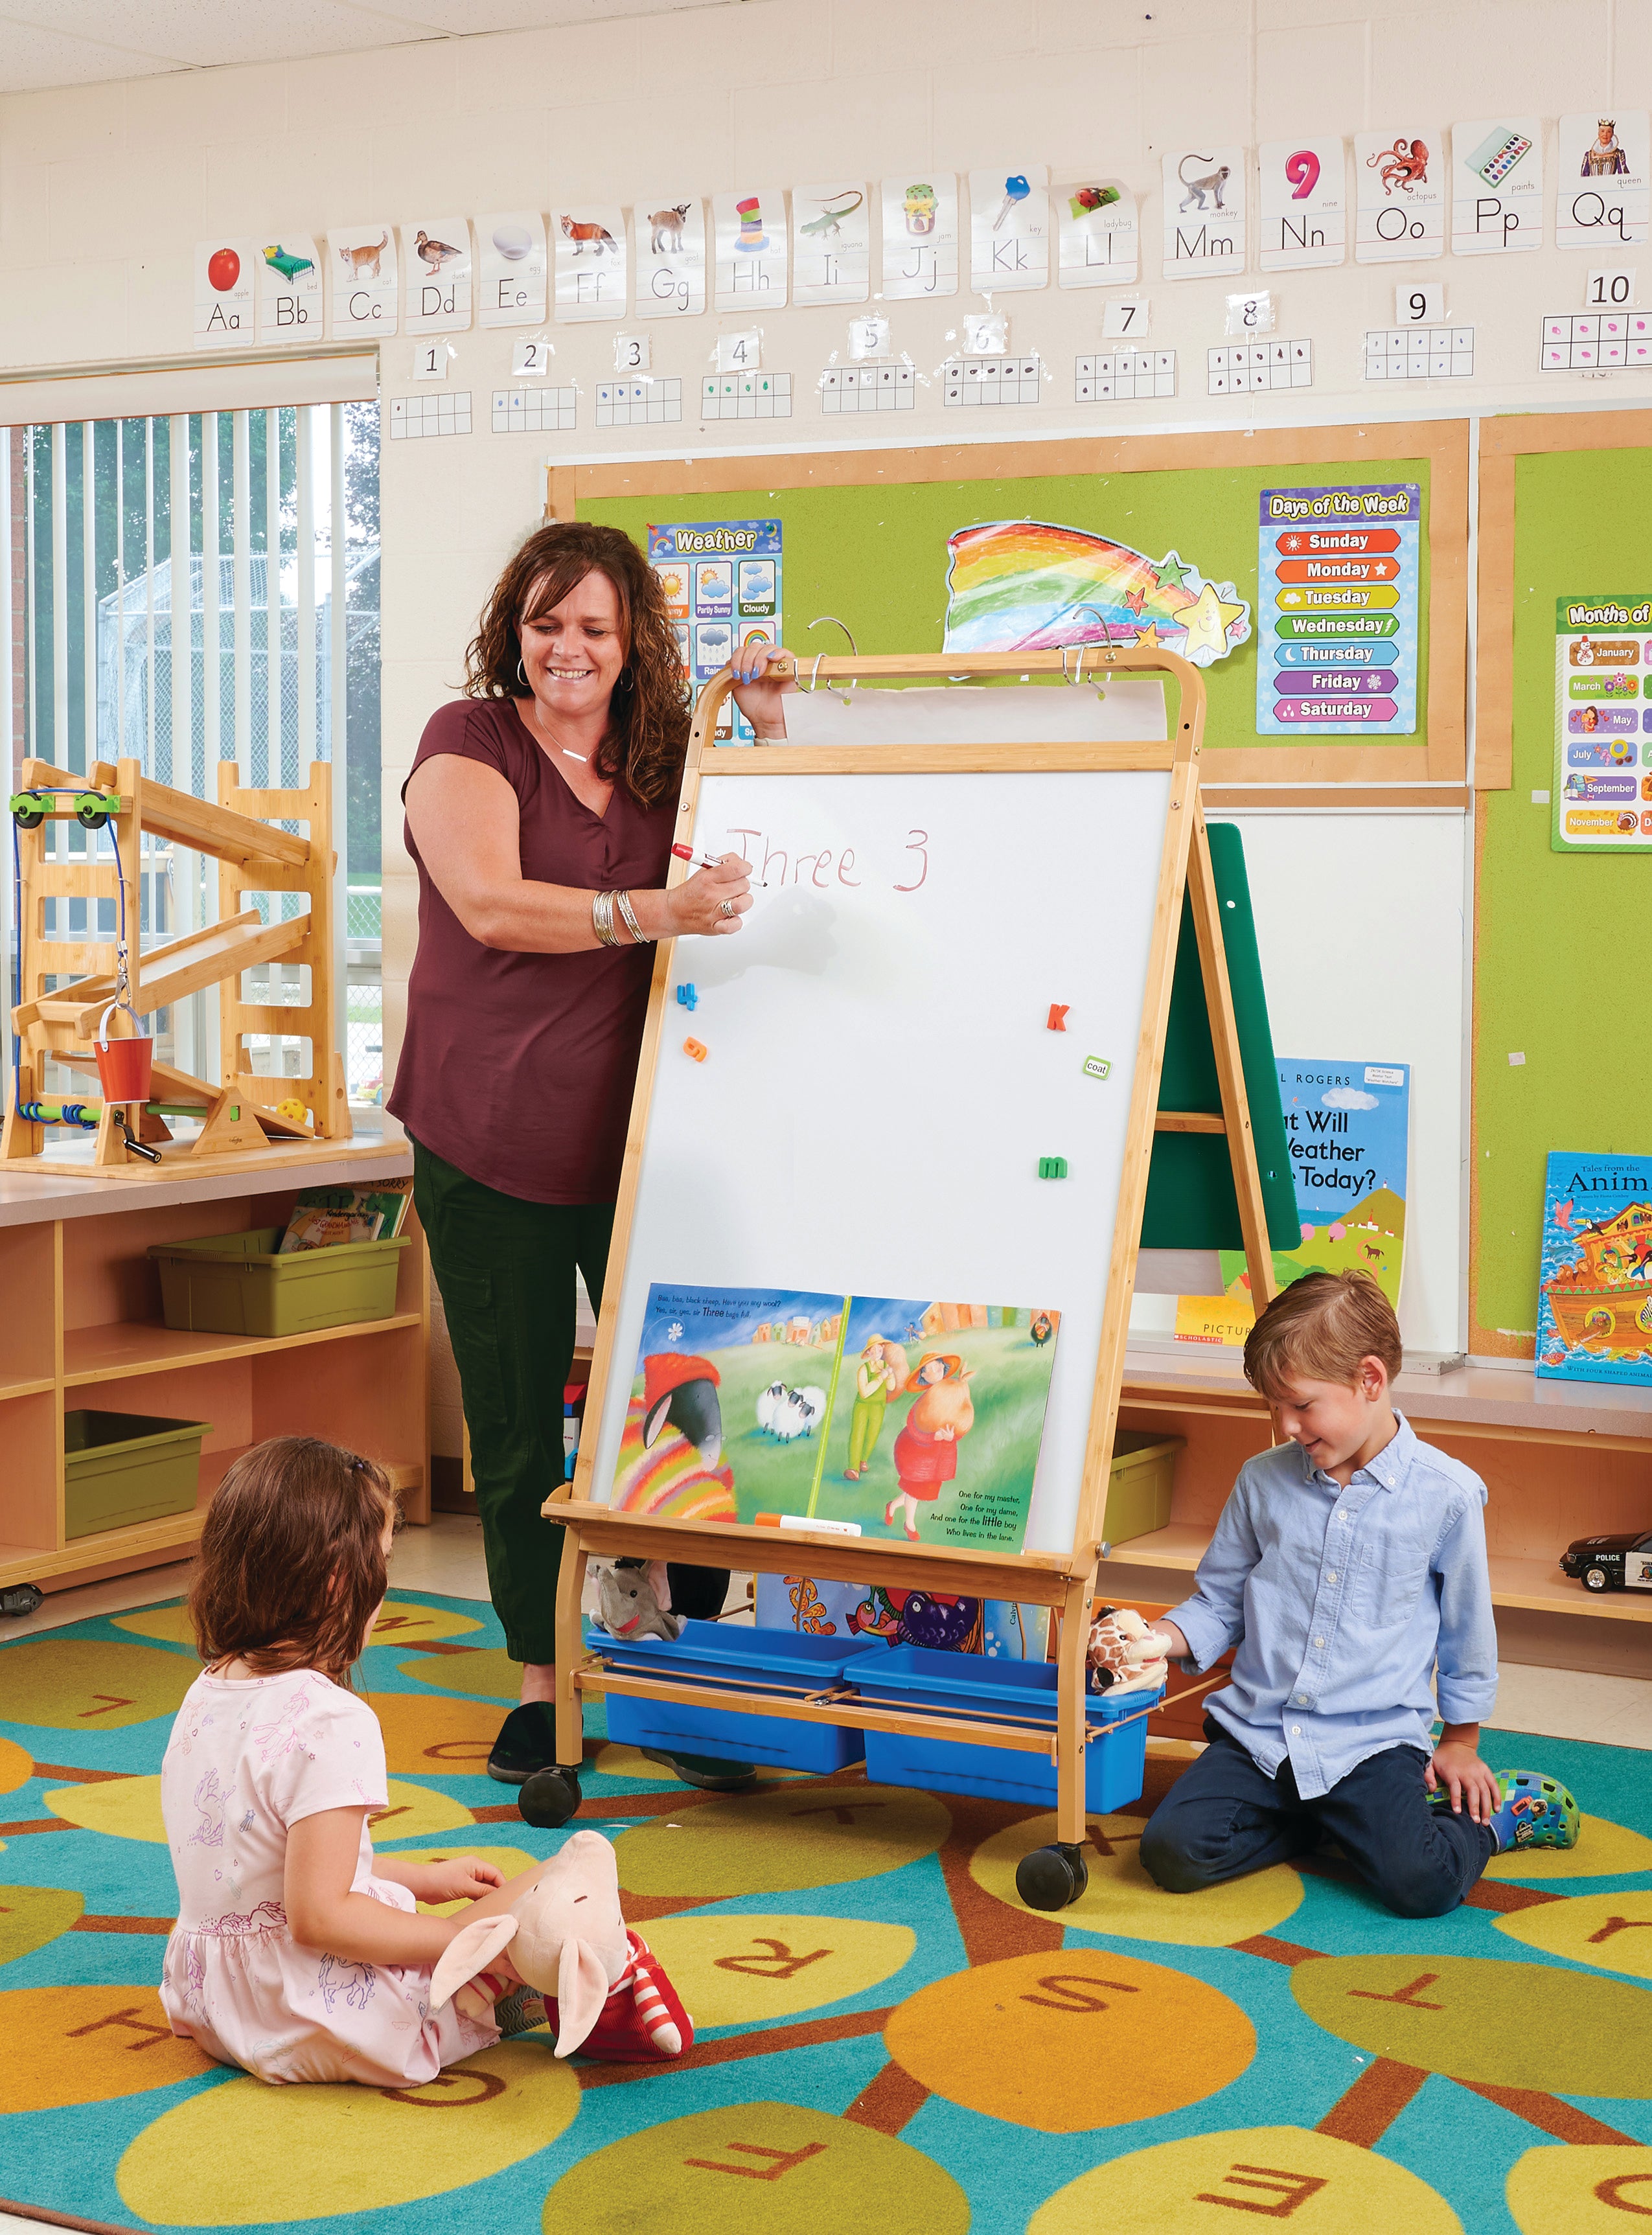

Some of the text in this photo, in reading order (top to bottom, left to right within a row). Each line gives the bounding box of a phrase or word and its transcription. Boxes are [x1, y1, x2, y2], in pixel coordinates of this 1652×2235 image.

[1511, 182, 1535, 193] paints
[1617, 177, 1642, 188] queen
[1406, 192, 1437, 202] octopus
[1104, 219, 1132, 229] ladybug
[1210, 209, 1239, 221] monkey
[1377, 208, 1425, 240] Oo
[1476, 198, 1519, 247] Pp
[1572, 192, 1632, 241] Qq
[937, 233, 952, 243] jam
[1029, 224, 1042, 235] key
[1281, 215, 1325, 249] Nn
[842, 241, 863, 251] iguana
[1086, 233, 1112, 266] Ll
[1176, 224, 1233, 259] Mm
[685, 254, 699, 264] goat
[992, 239, 1029, 272] Kk
[529, 266, 541, 275] egg
[733, 260, 770, 292] Hh
[823, 254, 838, 285] Ii
[902, 246, 937, 292] Jj
[234, 289, 249, 299] apple
[307, 282, 317, 290] bed
[498, 279, 527, 308] Ee
[577, 272, 606, 303] Ff
[651, 268, 689, 311] Gg
[1592, 276, 1629, 303] 10
[349, 291, 382, 320] Cc
[422, 284, 455, 315] Dd
[1409, 293, 1427, 320] 9
[207, 303, 240, 332] Aa
[277, 297, 308, 325] Bb
[1121, 307, 1136, 332] 7
[1243, 300, 1257, 327] 8
[865, 323, 878, 348] 5
[426, 349, 438, 372] 1
[523, 345, 536, 367] 2
[628, 342, 641, 365] 3
[732, 340, 748, 363] 4
[1272, 493, 1407, 518] Days of the Week
[676, 530, 755, 552] Weather
[1309, 534, 1369, 551] Sunday
[1307, 562, 1370, 579] Monday
[743, 604, 770, 614] Cloudy
[1305, 590, 1370, 606] Tuesday
[697, 605, 731, 615] Partly Sunny
[1569, 604, 1650, 625] Months of
[1292, 617, 1384, 635] Wednesday
[1301, 646, 1373, 663] Thursday
[1596, 648, 1634, 658] January
[1312, 674, 1361, 691] Friday
[1573, 682, 1601, 691] March
[1300, 701, 1371, 718] Saturday
[1613, 715, 1632, 726] May
[1573, 749, 1592, 759] July
[1587, 783, 1635, 794] September
[1570, 818, 1613, 827] November
[726, 829, 928, 891] Three 3
[1087, 1062, 1107, 1074] coat
[1296, 1074, 1350, 1086] ROGERS
[1305, 1110, 1348, 1134] Will
[1299, 1165, 1376, 1197] Today?
[703, 1307, 724, 1317] Three
[959, 1490, 971, 1498] One
[985, 1495, 995, 1503] my
[982, 1515, 1002, 1528] little
[1004, 1520, 1017, 1531] boy
[986, 1507, 997, 1516] my
[999, 1507, 1018, 1517] dame,
[946, 1528, 961, 1536] Who
[962, 1530, 977, 1538] lives
[987, 1531, 997, 1540] the
[998, 1533, 1014, 1542] lane.
[714, 1938, 834, 1979] R
[1020, 1974, 1141, 2013] S
[1346, 1973, 1447, 2010] T
[683, 2142, 830, 2181] F
[1192, 2164, 1330, 2218] E
